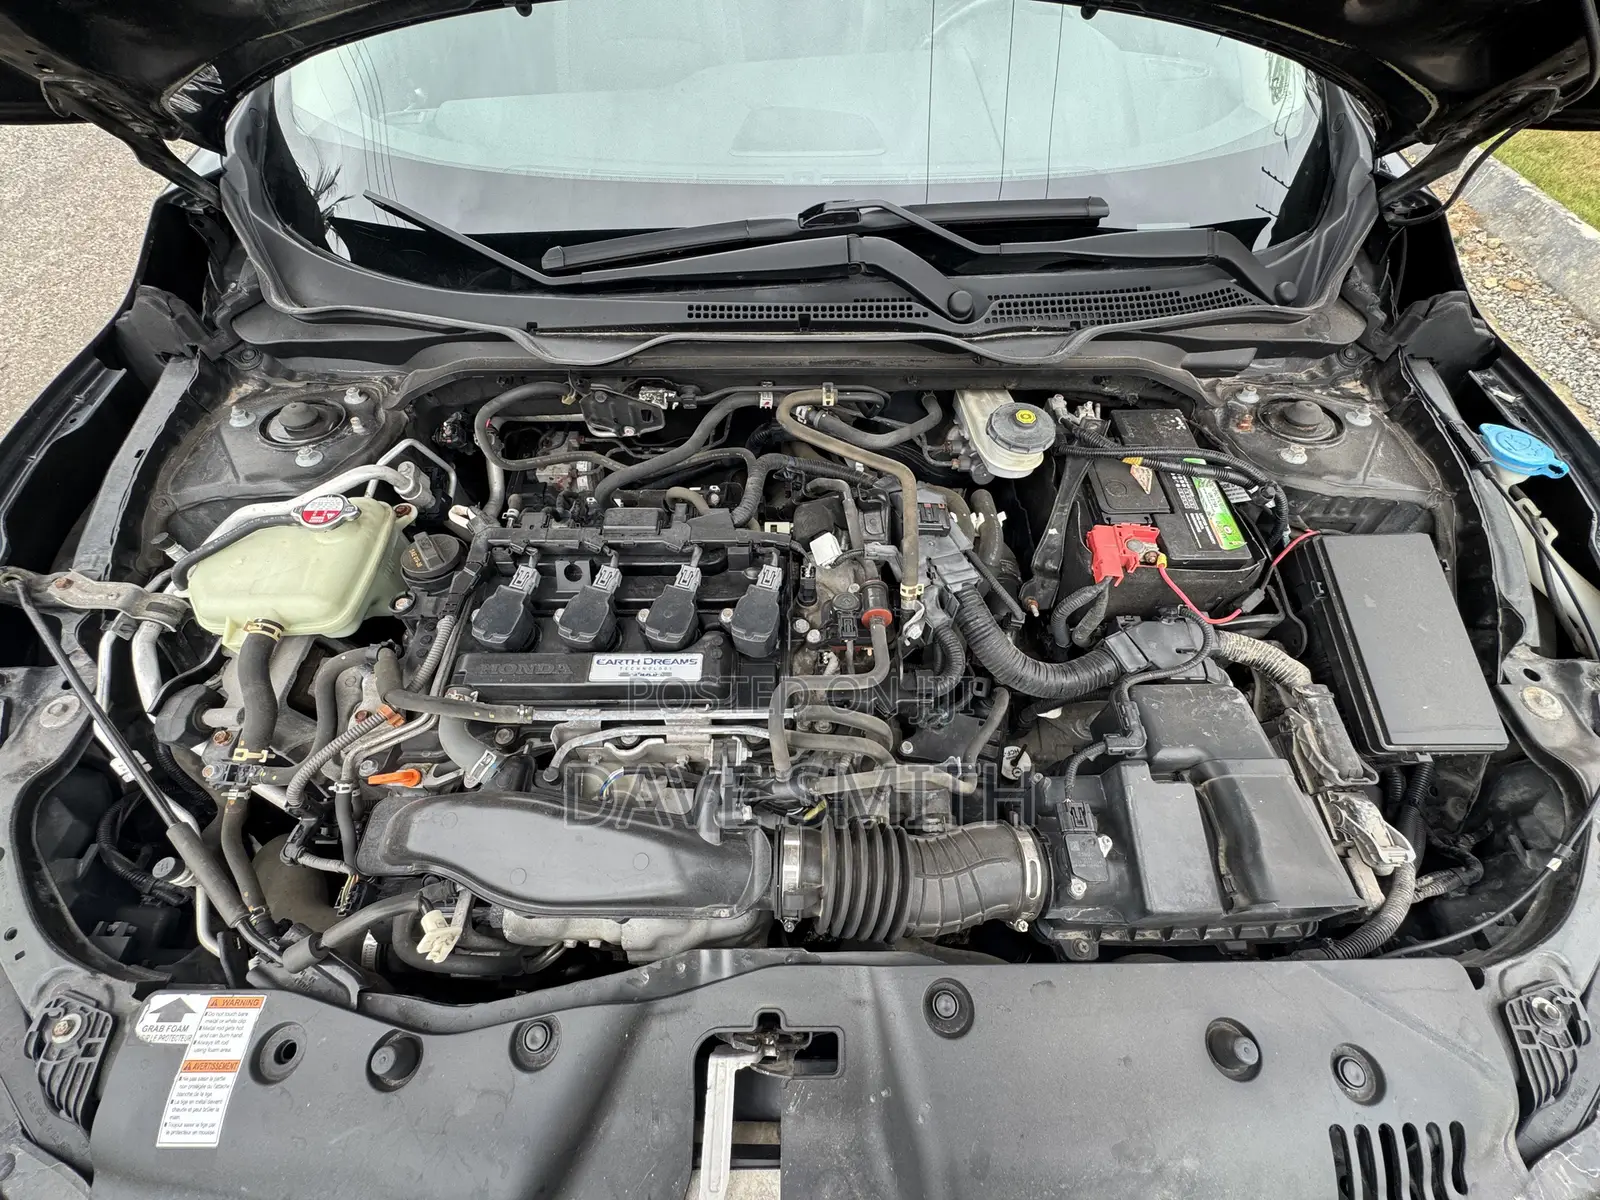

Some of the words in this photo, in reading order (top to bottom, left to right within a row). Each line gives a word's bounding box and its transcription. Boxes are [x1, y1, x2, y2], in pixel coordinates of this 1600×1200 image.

[596, 658, 641, 666] EARTH
[643, 657, 698, 666] DREAMS
[479, 663, 573, 675] HONDA
[142, 1024, 165, 1032] GRAB
[166, 1024, 190, 1032] FOAM
[158, 1034, 193, 1042] PROTECTEUR
[192, 1062, 238, 1070] AVERTISSEMENT
